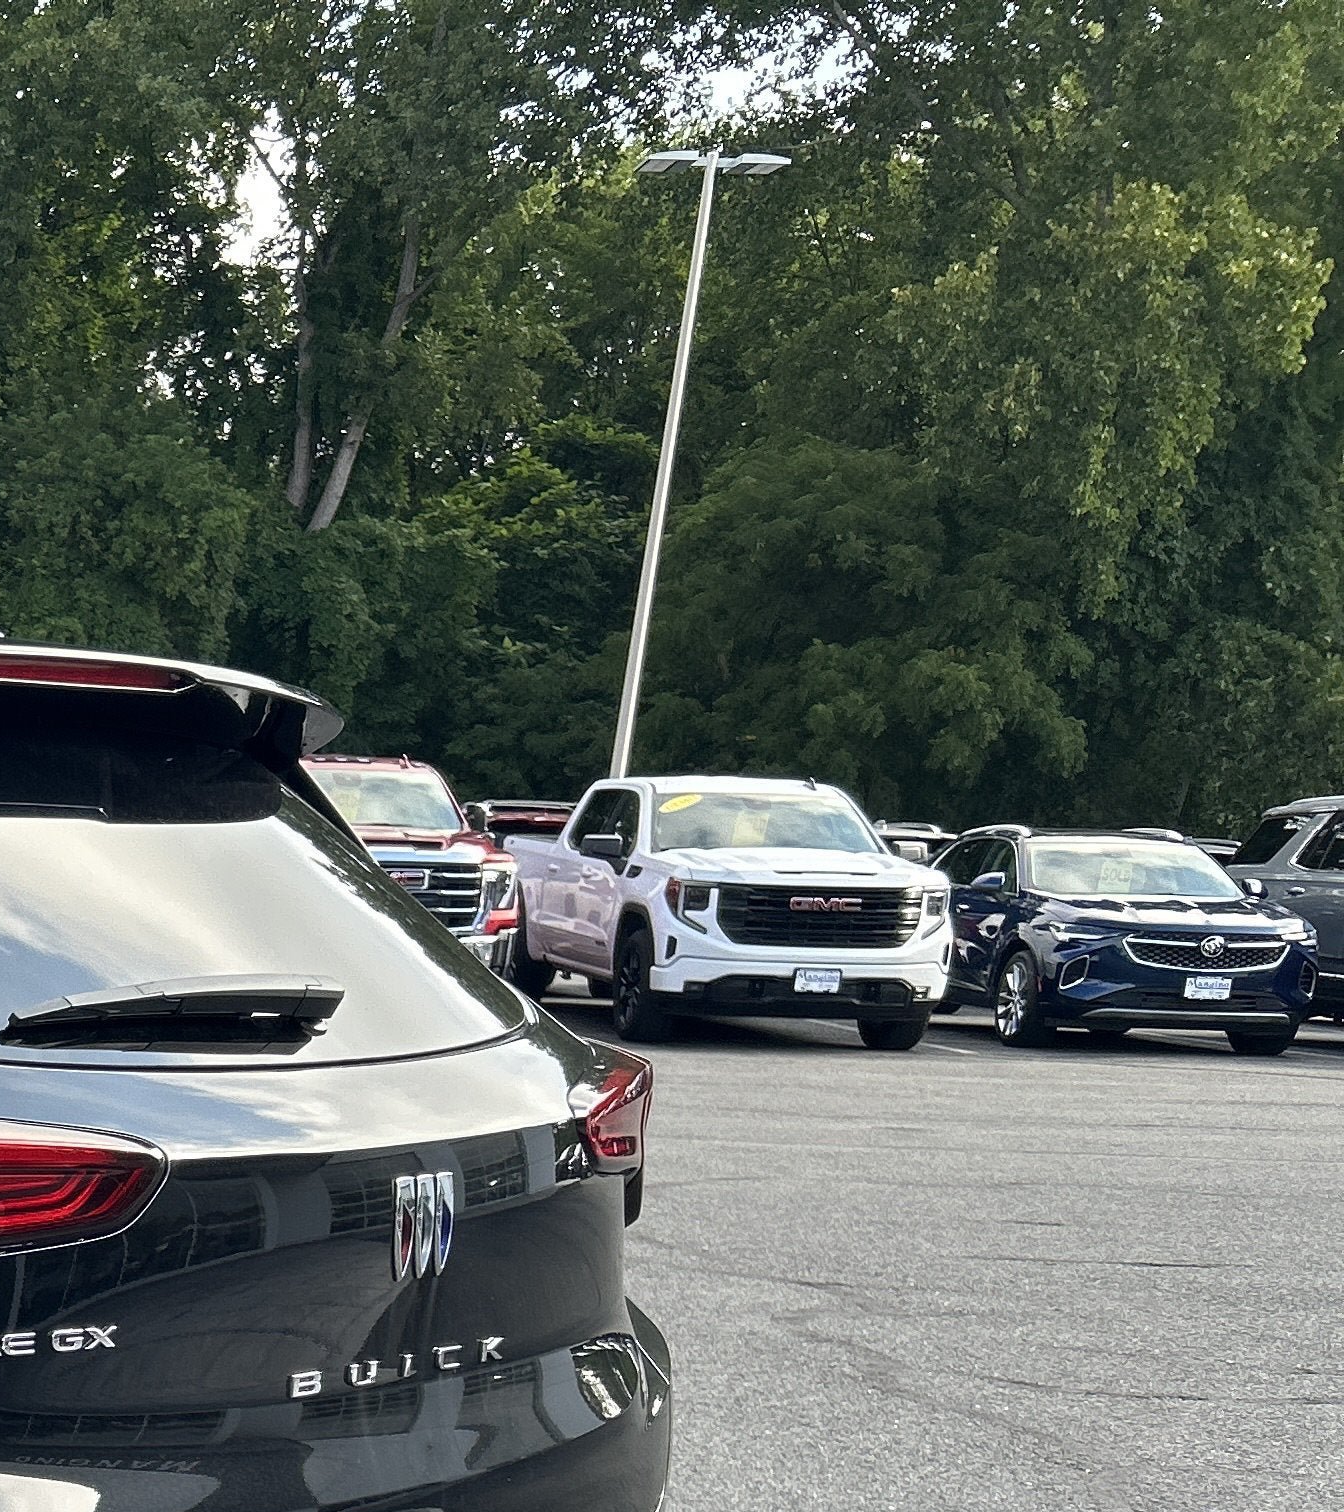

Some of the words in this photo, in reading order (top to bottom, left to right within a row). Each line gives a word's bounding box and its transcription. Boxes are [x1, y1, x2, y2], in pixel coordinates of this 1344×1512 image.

[790, 897, 862, 911] GMC
[50, 1324, 119, 1353] GX
[287, 1336, 505, 1399] BUICK
